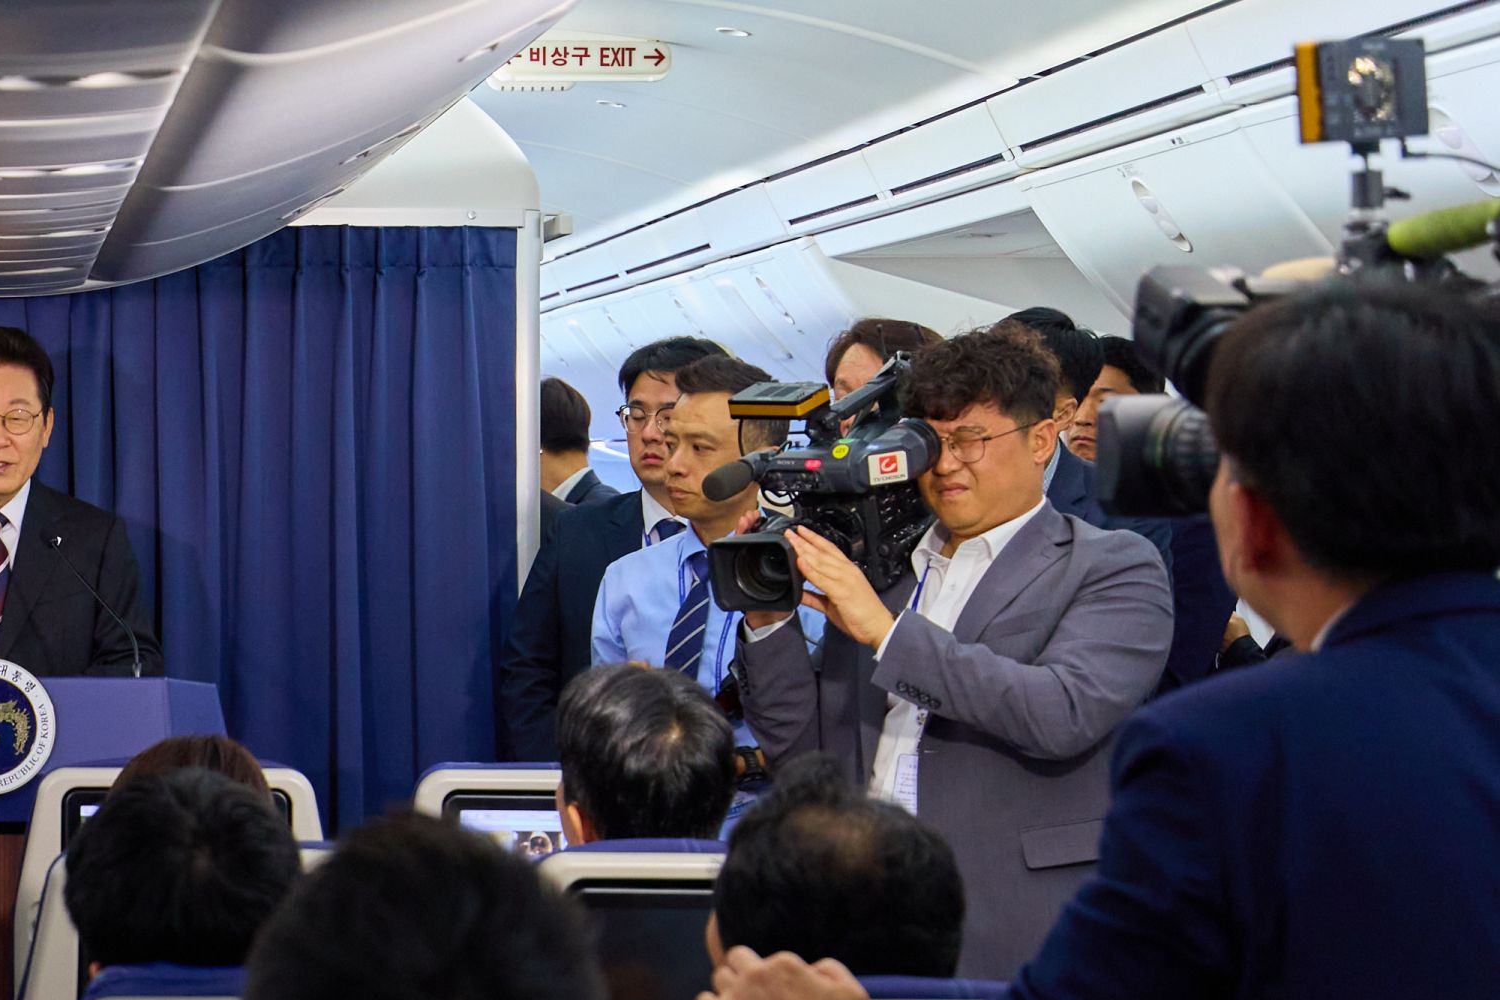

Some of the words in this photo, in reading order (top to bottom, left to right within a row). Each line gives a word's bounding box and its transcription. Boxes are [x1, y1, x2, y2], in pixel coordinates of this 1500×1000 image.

[529, 46, 591, 67] 비상구
[599, 47, 636, 67] EXIT
[39, 703, 50, 740] KOREA
[36, 740, 47, 755] OF
